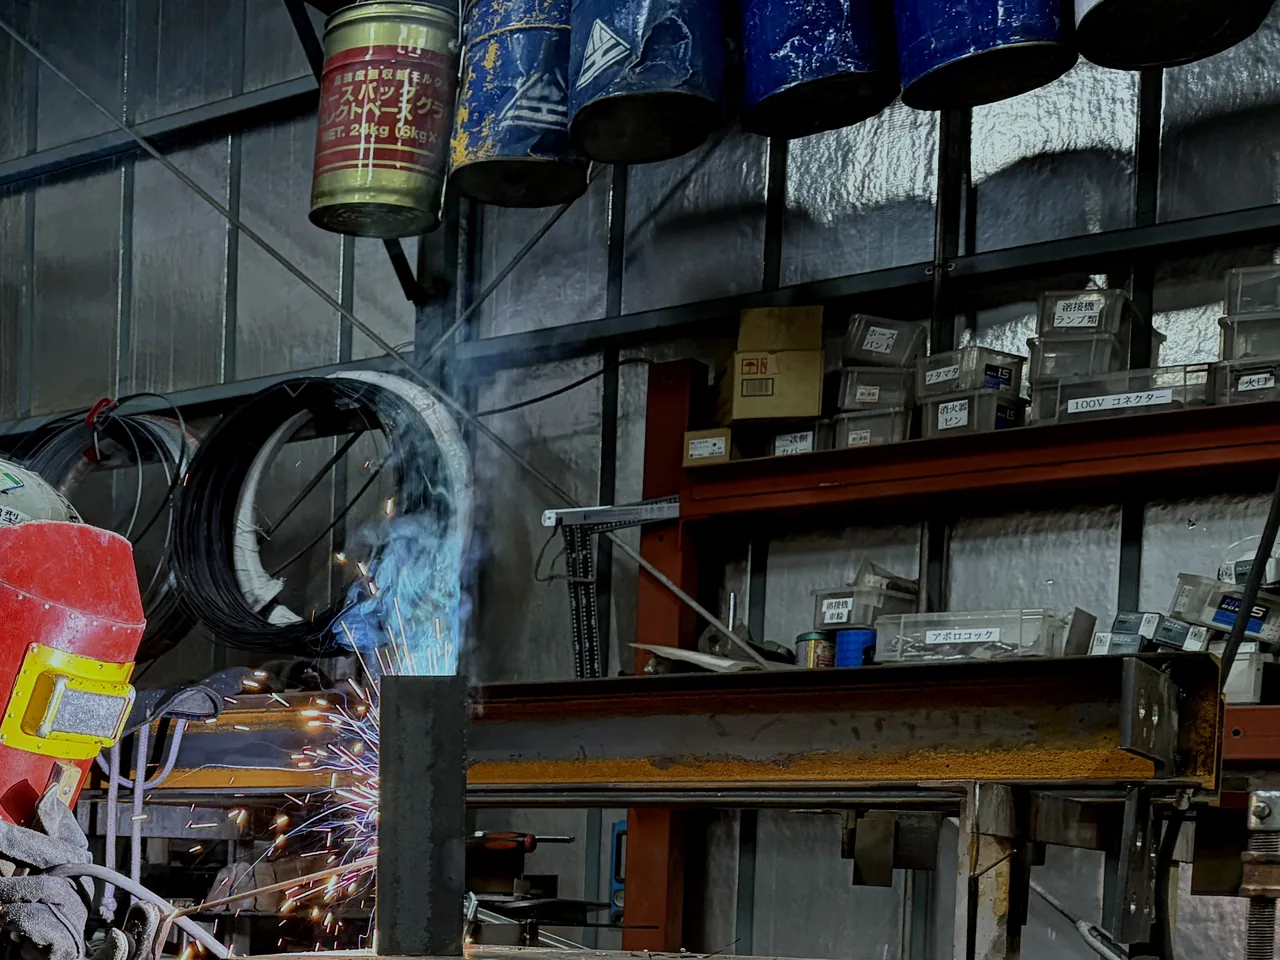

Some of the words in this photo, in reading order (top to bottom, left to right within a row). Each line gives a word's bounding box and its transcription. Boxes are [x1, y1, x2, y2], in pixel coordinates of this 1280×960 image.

[1062, 301, 1095, 313] 溶接機
[1073, 397, 1105, 411] 100V
[1111, 391, 1168, 407] コネクター
[939, 401, 968, 415] 消火器
[932, 629, 994, 642] アポロコック
